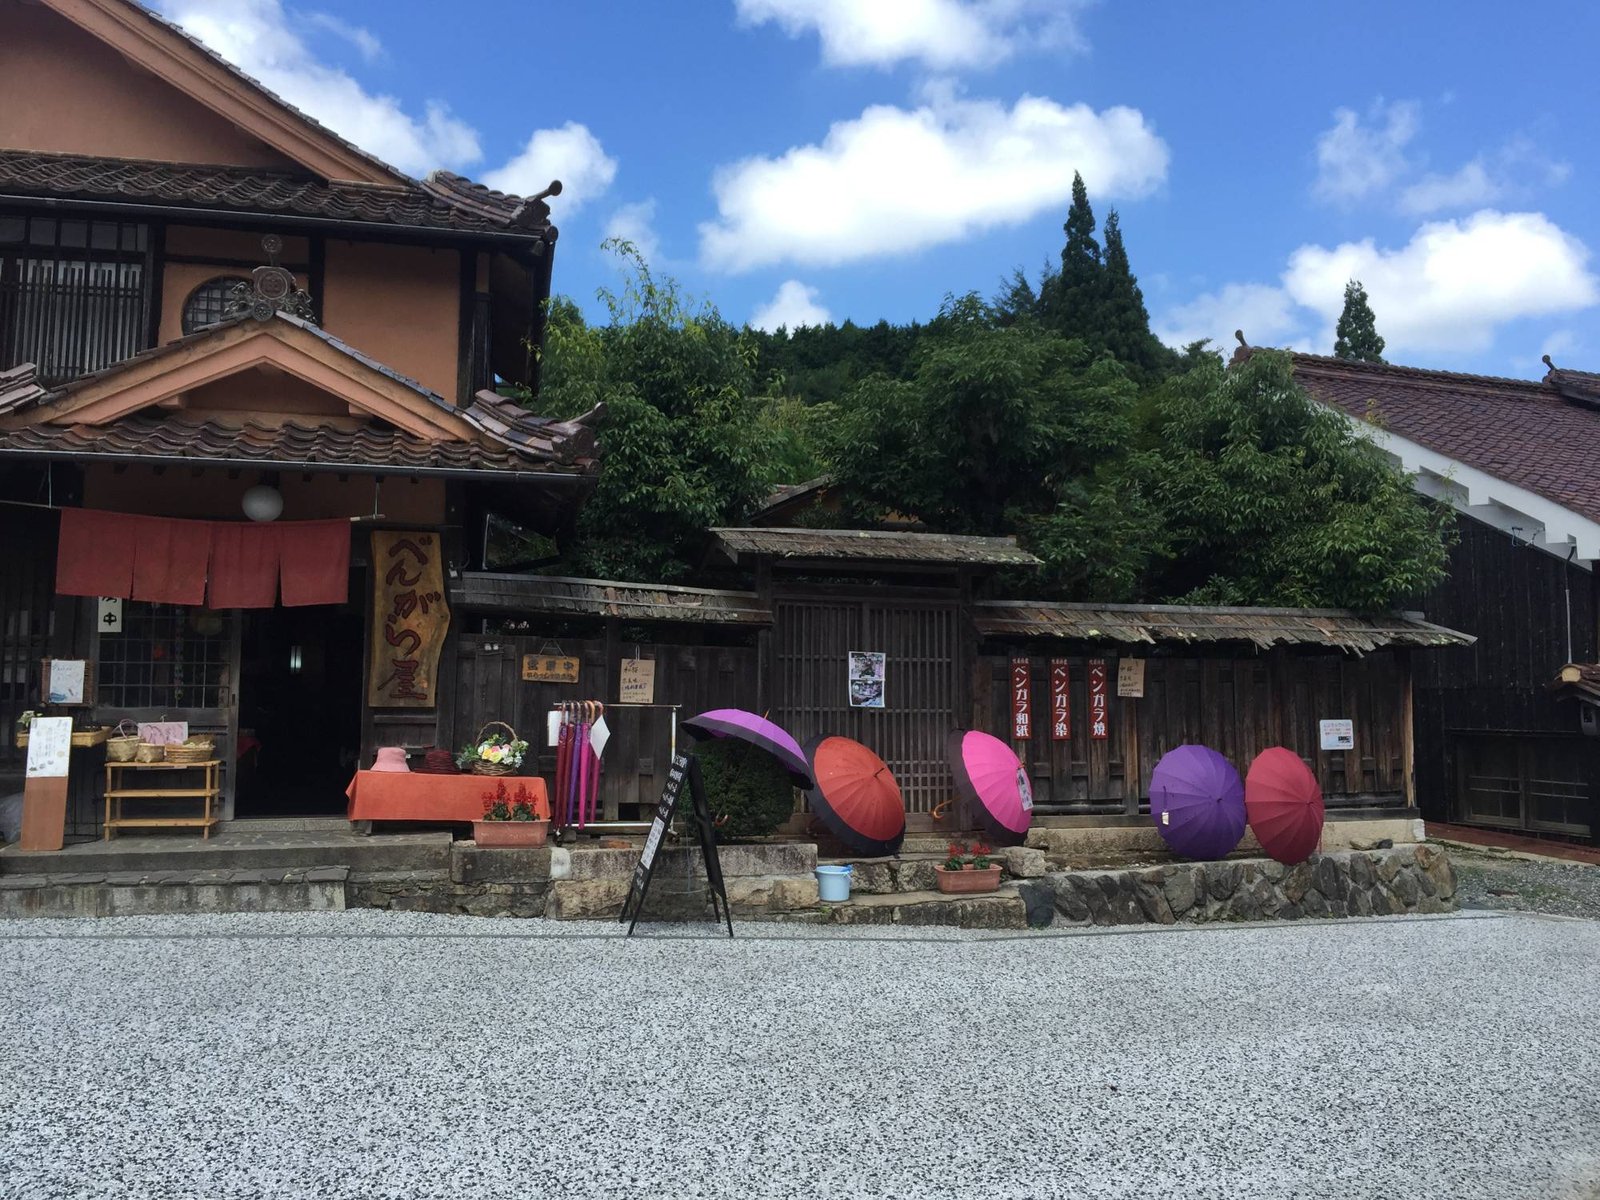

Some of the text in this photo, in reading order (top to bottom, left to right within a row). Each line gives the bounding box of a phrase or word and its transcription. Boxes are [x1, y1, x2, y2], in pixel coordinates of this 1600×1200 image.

[377, 535, 441, 700] べんがら屋
[1014, 666, 1029, 737] ベンガラ和紙
[1054, 666, 1068, 737] ベンガラ染
[1091, 667, 1106, 736] ベンガラ焼
